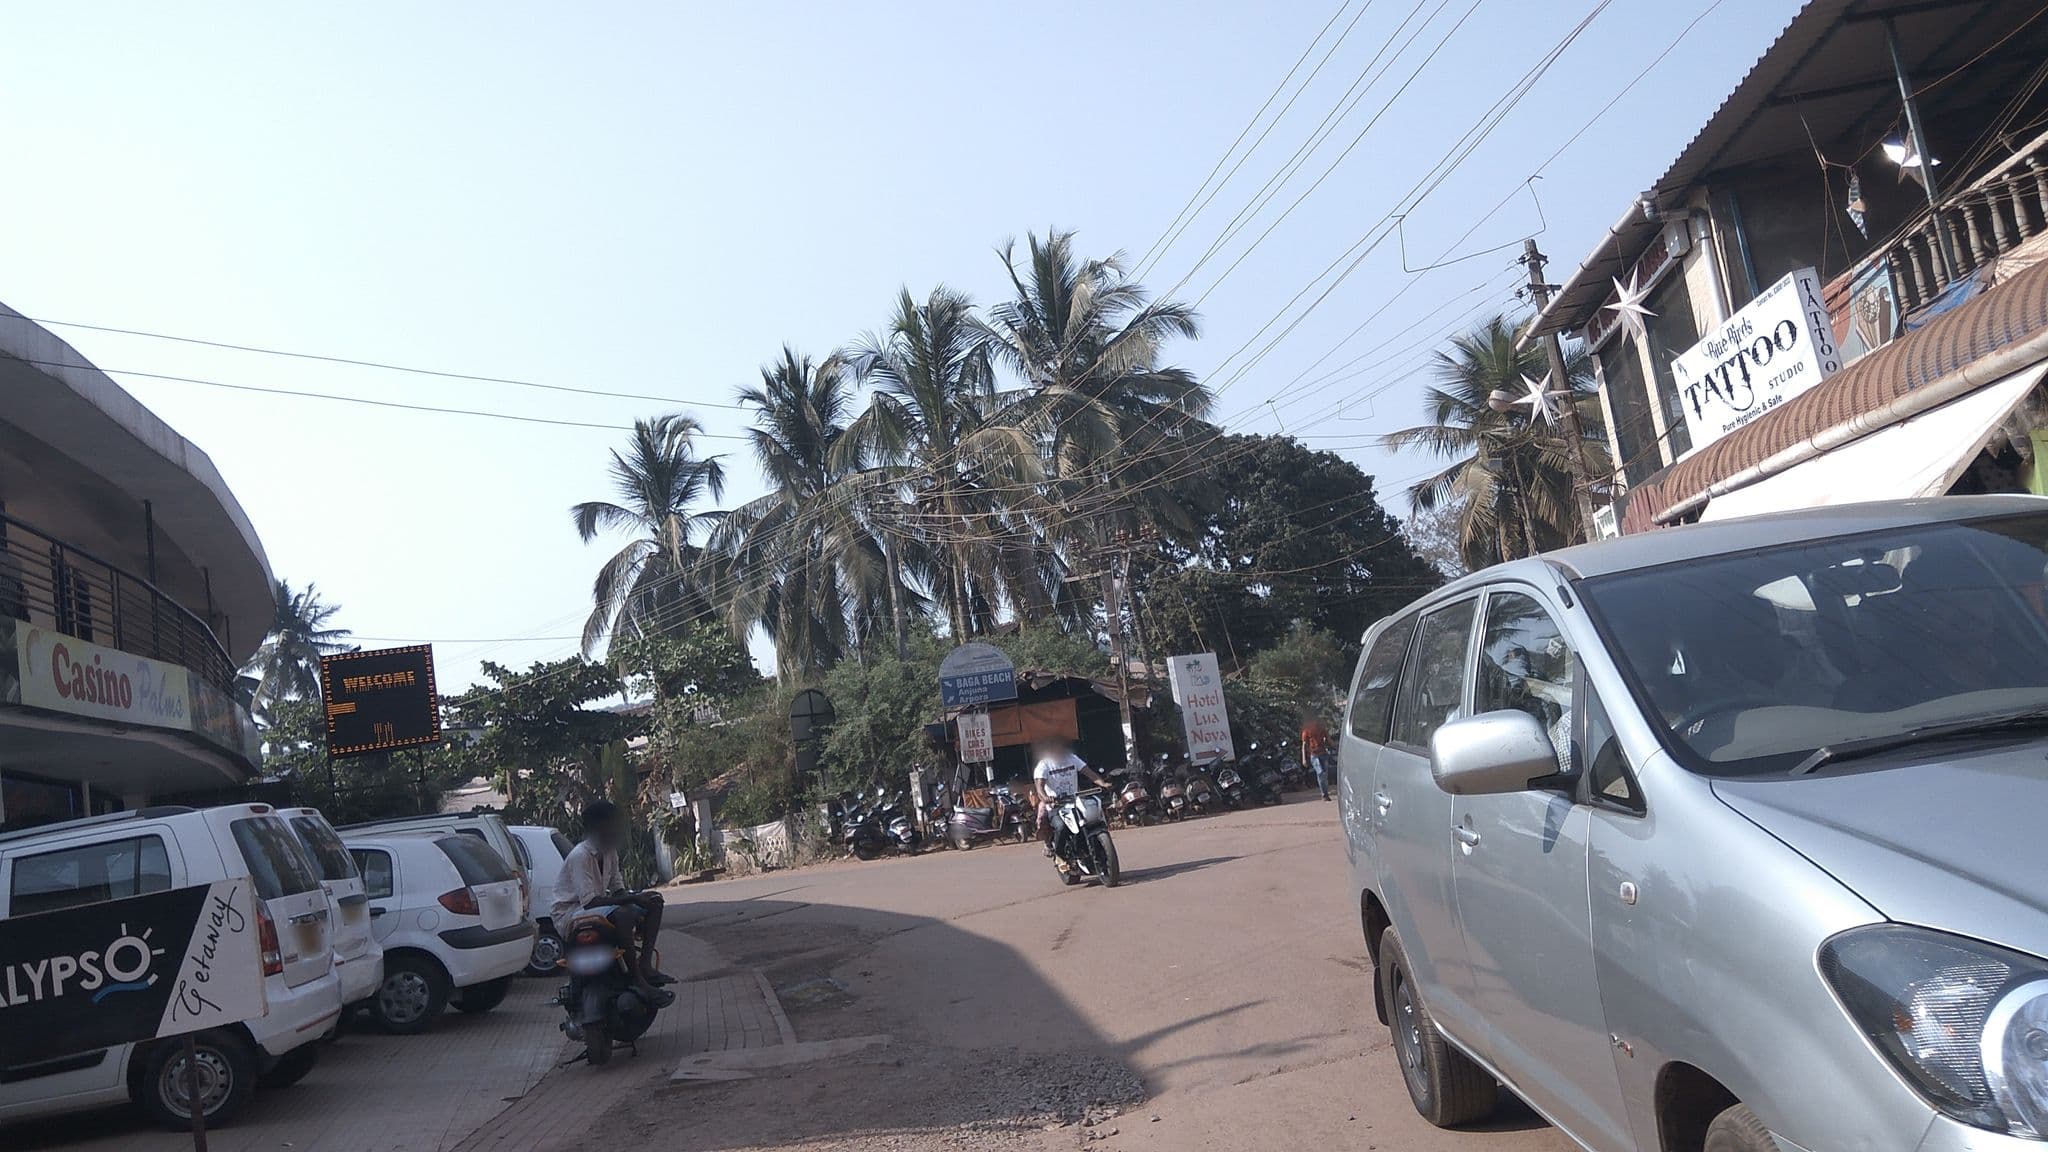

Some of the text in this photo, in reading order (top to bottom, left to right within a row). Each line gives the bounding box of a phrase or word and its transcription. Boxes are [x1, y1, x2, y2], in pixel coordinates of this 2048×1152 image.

[1799, 278, 1838, 373] TATTOO
[1684, 319, 1798, 421] TATTOO
[1768, 361, 1804, 390] STUDIO
[1722, 394, 1783, 433] Pure Hygienic & Safe
[52, 642, 184, 719] Casino Palms
[343, 671, 417, 690] WELCOME
[956, 671, 1012, 689] BAGA BEACH
[958, 686, 988, 697] Anjuna
[1187, 689, 1220, 708] Hotel
[1194, 712, 1220, 726] Lua
[964, 728, 986, 739] BIKES
[1191, 729, 1228, 744] Nova
[172, 886, 245, 1022] Getaway
